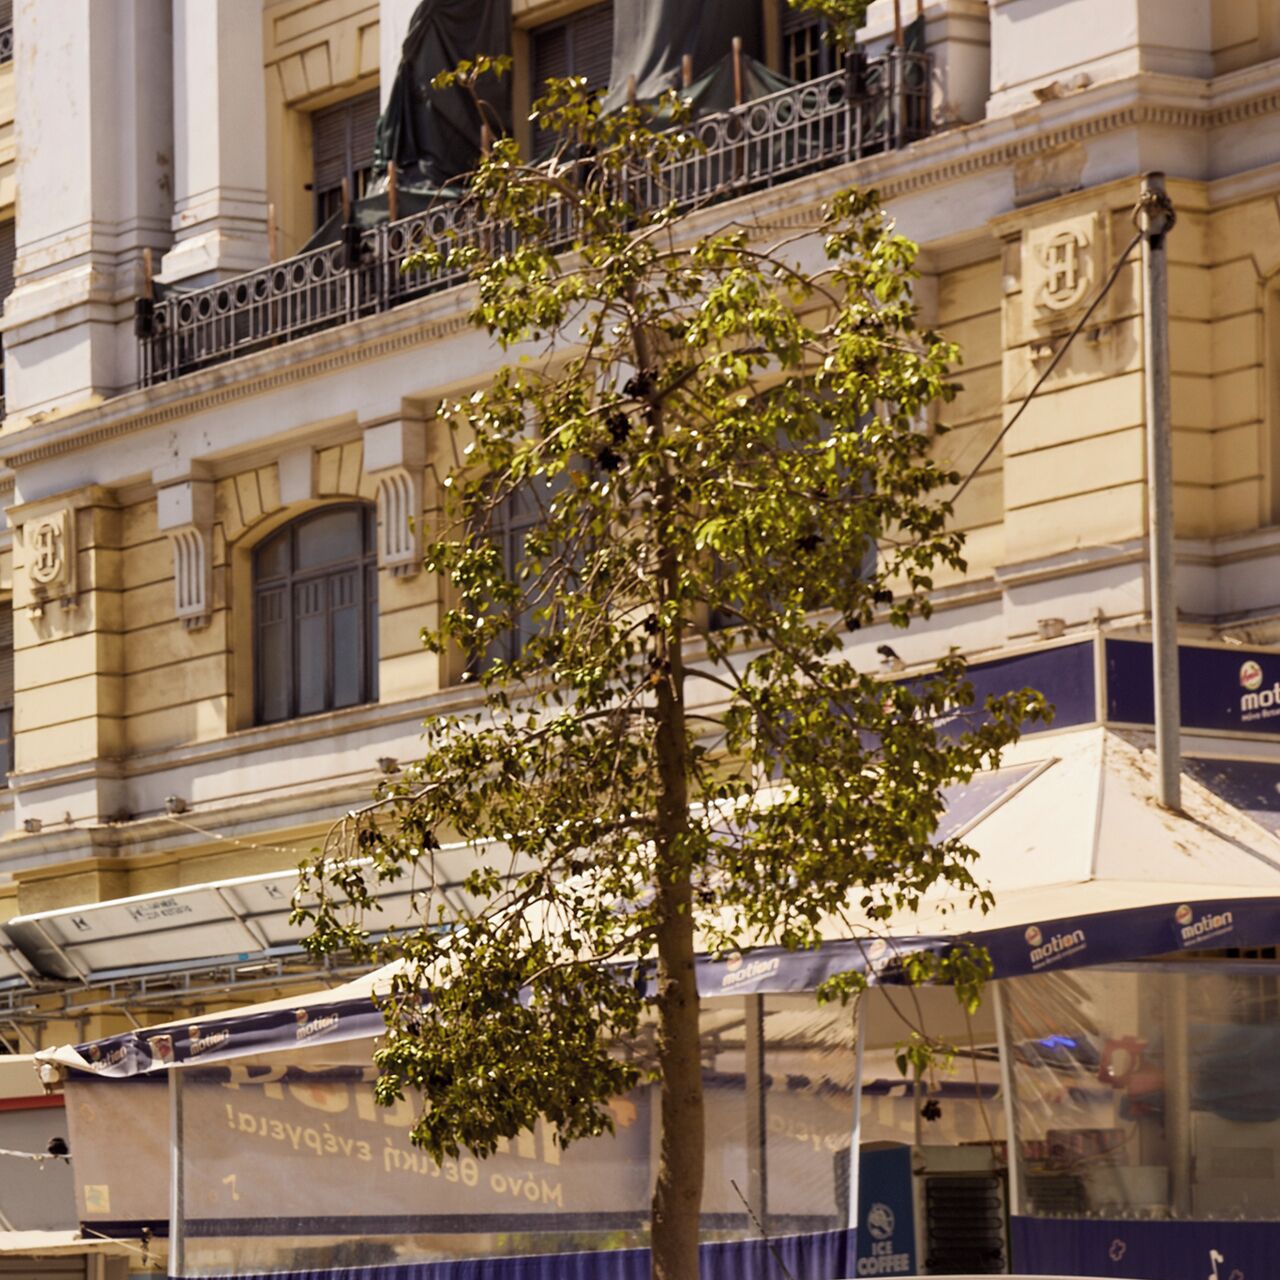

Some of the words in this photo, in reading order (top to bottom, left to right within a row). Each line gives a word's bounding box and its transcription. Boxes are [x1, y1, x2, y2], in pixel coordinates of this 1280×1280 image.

[1180, 911, 1233, 940] motion
[1030, 929, 1085, 963] motion
[722, 957, 780, 986] motion
[296, 1013, 339, 1041] motion
[190, 1029, 230, 1055] motion
[871, 1240, 893, 1256] ICE
[857, 1253, 910, 1275] COFFEE
